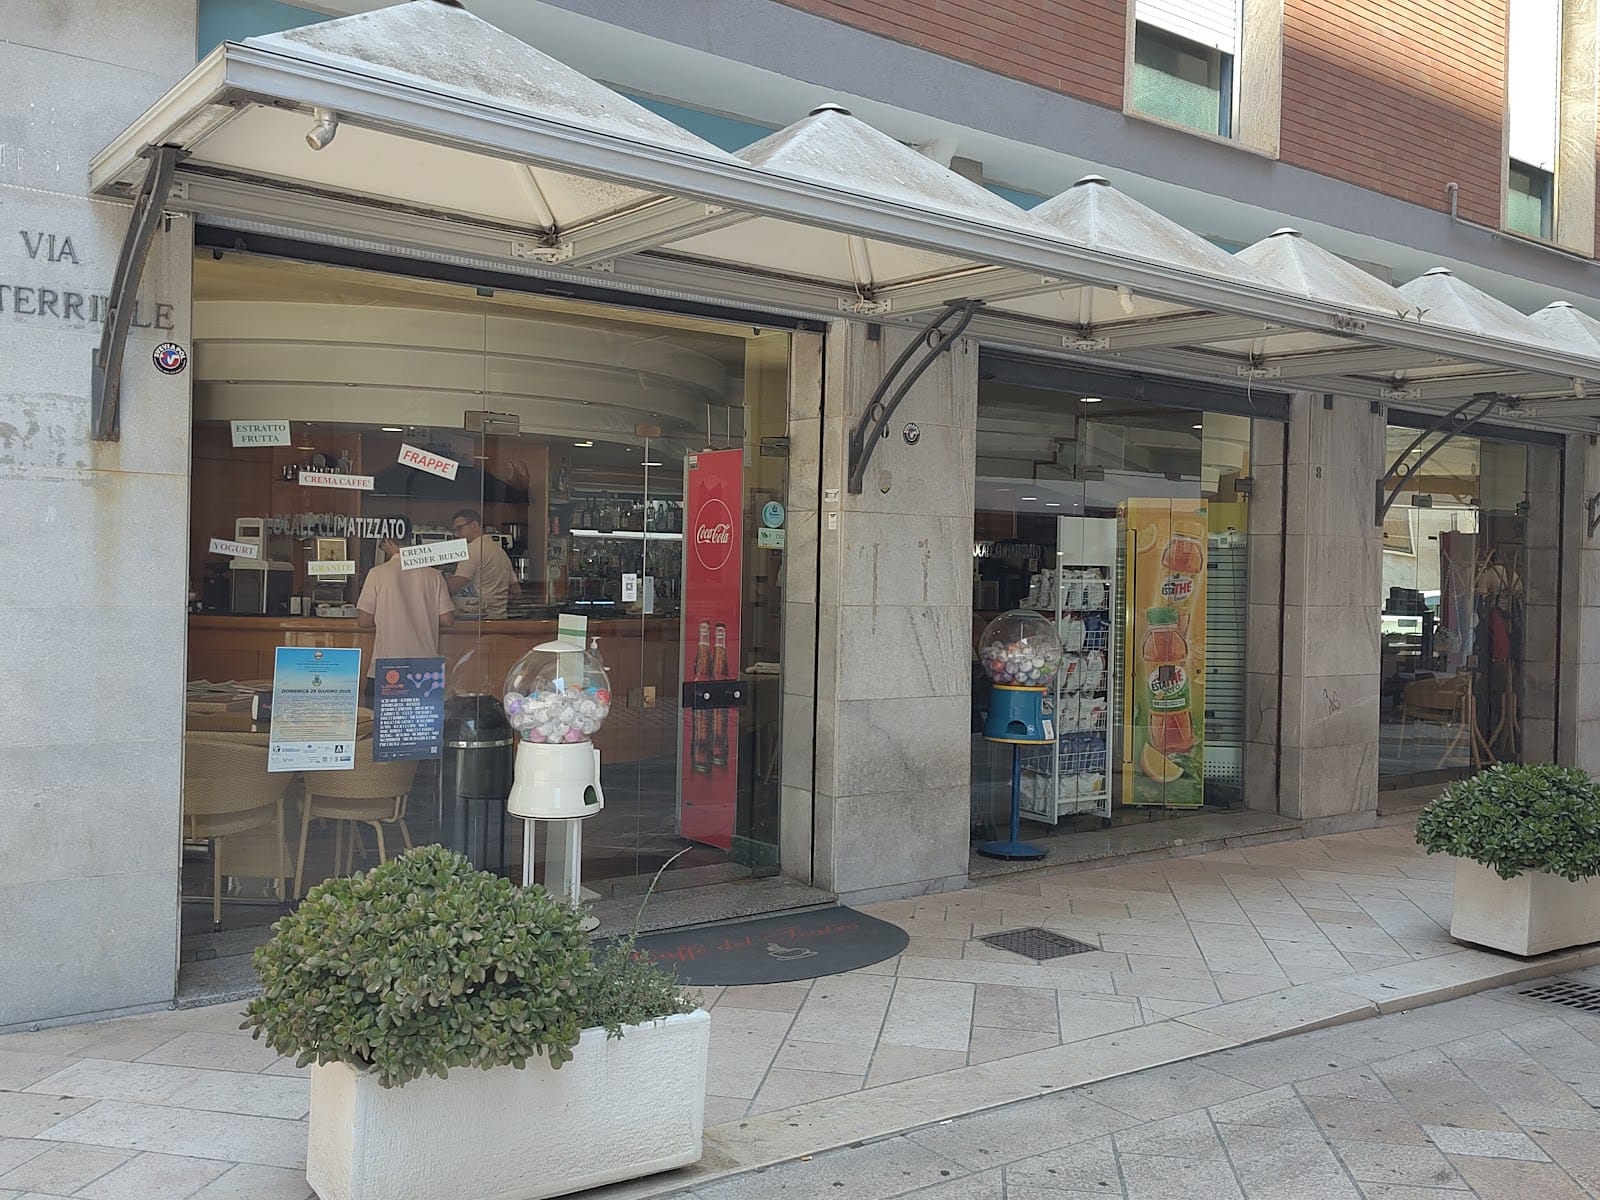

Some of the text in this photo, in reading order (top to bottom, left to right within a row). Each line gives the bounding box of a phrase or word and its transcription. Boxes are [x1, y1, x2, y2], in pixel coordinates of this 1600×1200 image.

[20, 231, 79, 264] VIA
[0, 285, 175, 330] TERRILE
[235, 423, 286, 433] ESTRATTO
[241, 433, 280, 443] FRUTTA
[402, 450, 455, 474] FRAPPE'
[304, 475, 338, 485] CREMA
[317, 514, 406, 540] CLIMATIZZATO
[697, 523, 731, 544] Coca-Cola
[214, 542, 254, 555] YOGURT
[401, 546, 432, 557] CREMA
[403, 550, 467, 567] KINDER BUENO
